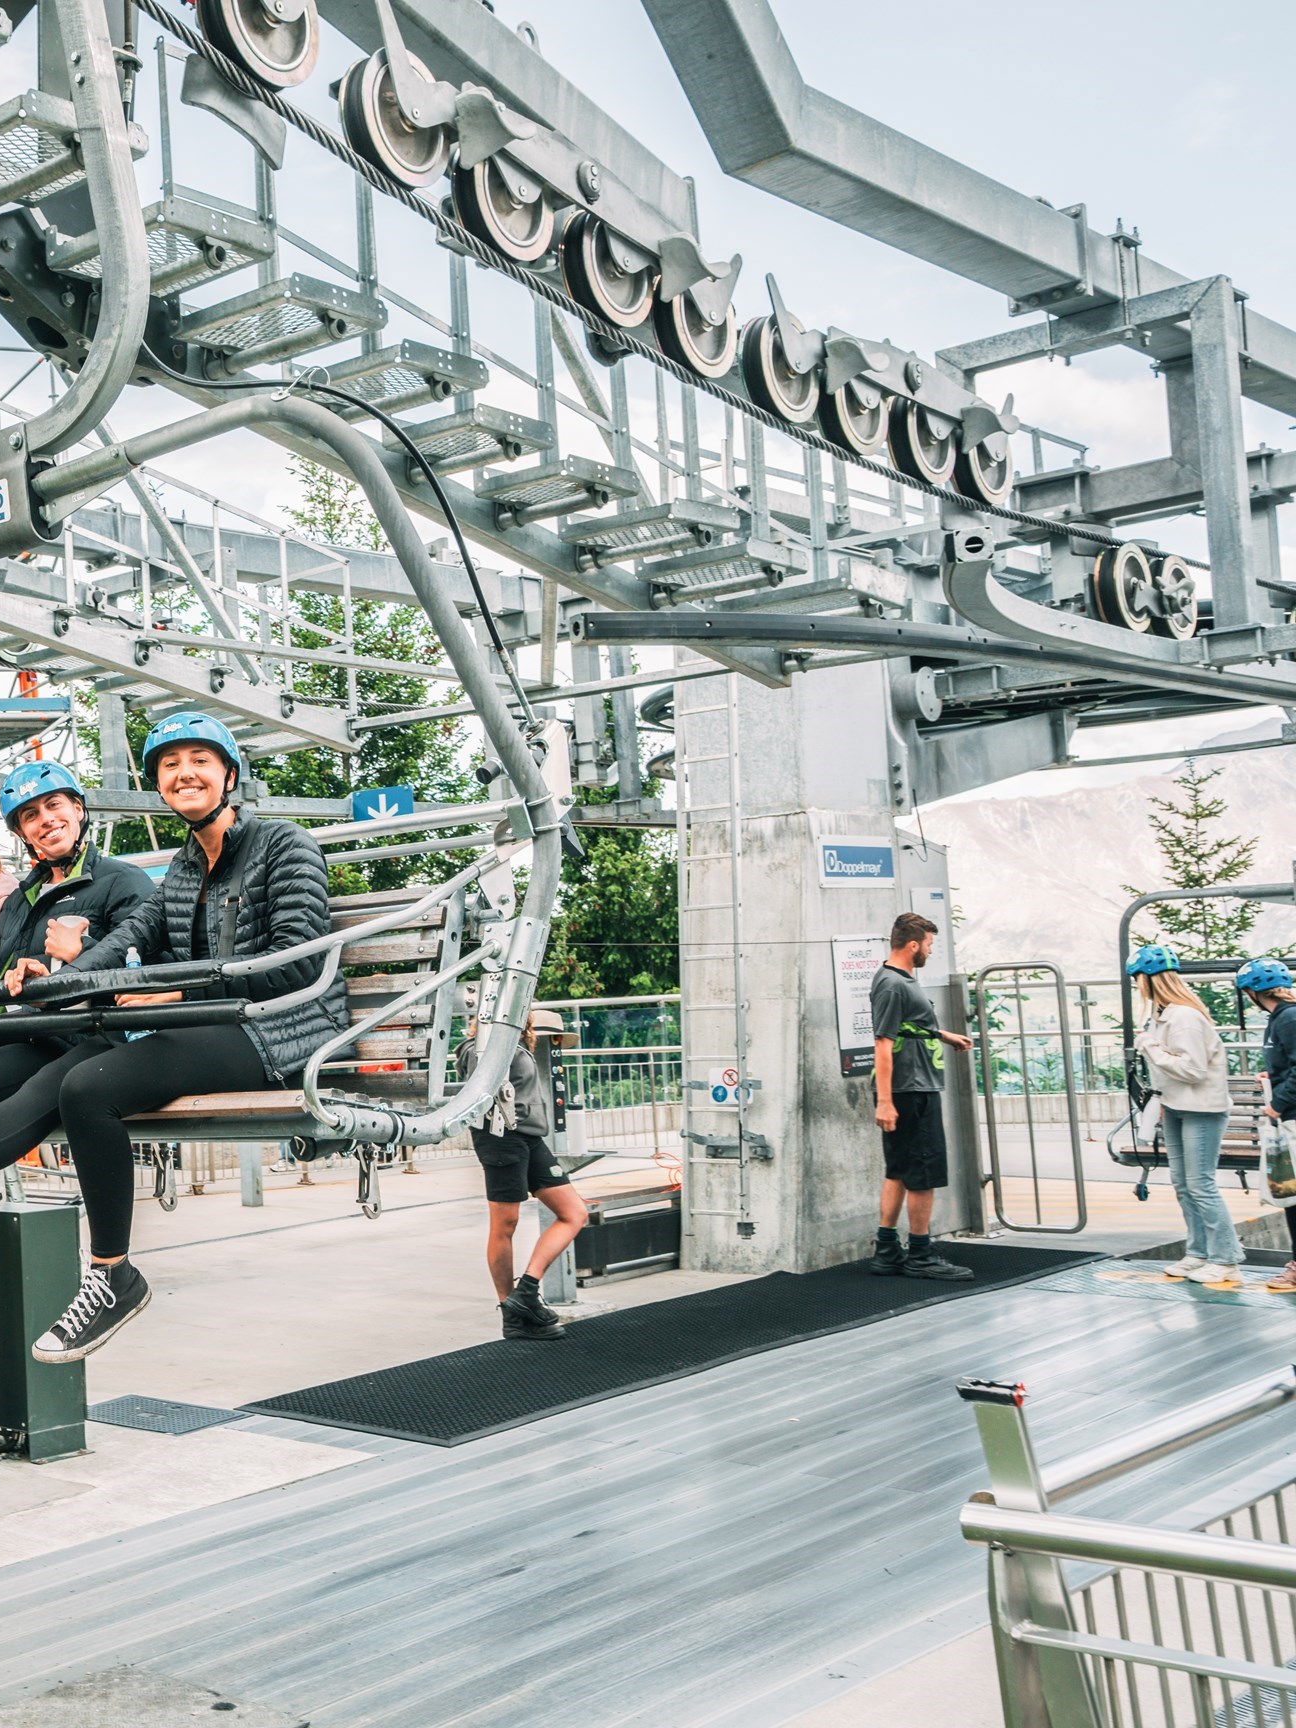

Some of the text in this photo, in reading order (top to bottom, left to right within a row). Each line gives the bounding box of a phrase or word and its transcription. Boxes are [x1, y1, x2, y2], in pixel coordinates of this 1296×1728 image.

[836, 860, 882, 876] Doppelmayr
[847, 949, 872, 959] CHAIRLIFT
[841, 959, 879, 970] DOES NOT STOP
[842, 972, 853, 980] FOR
